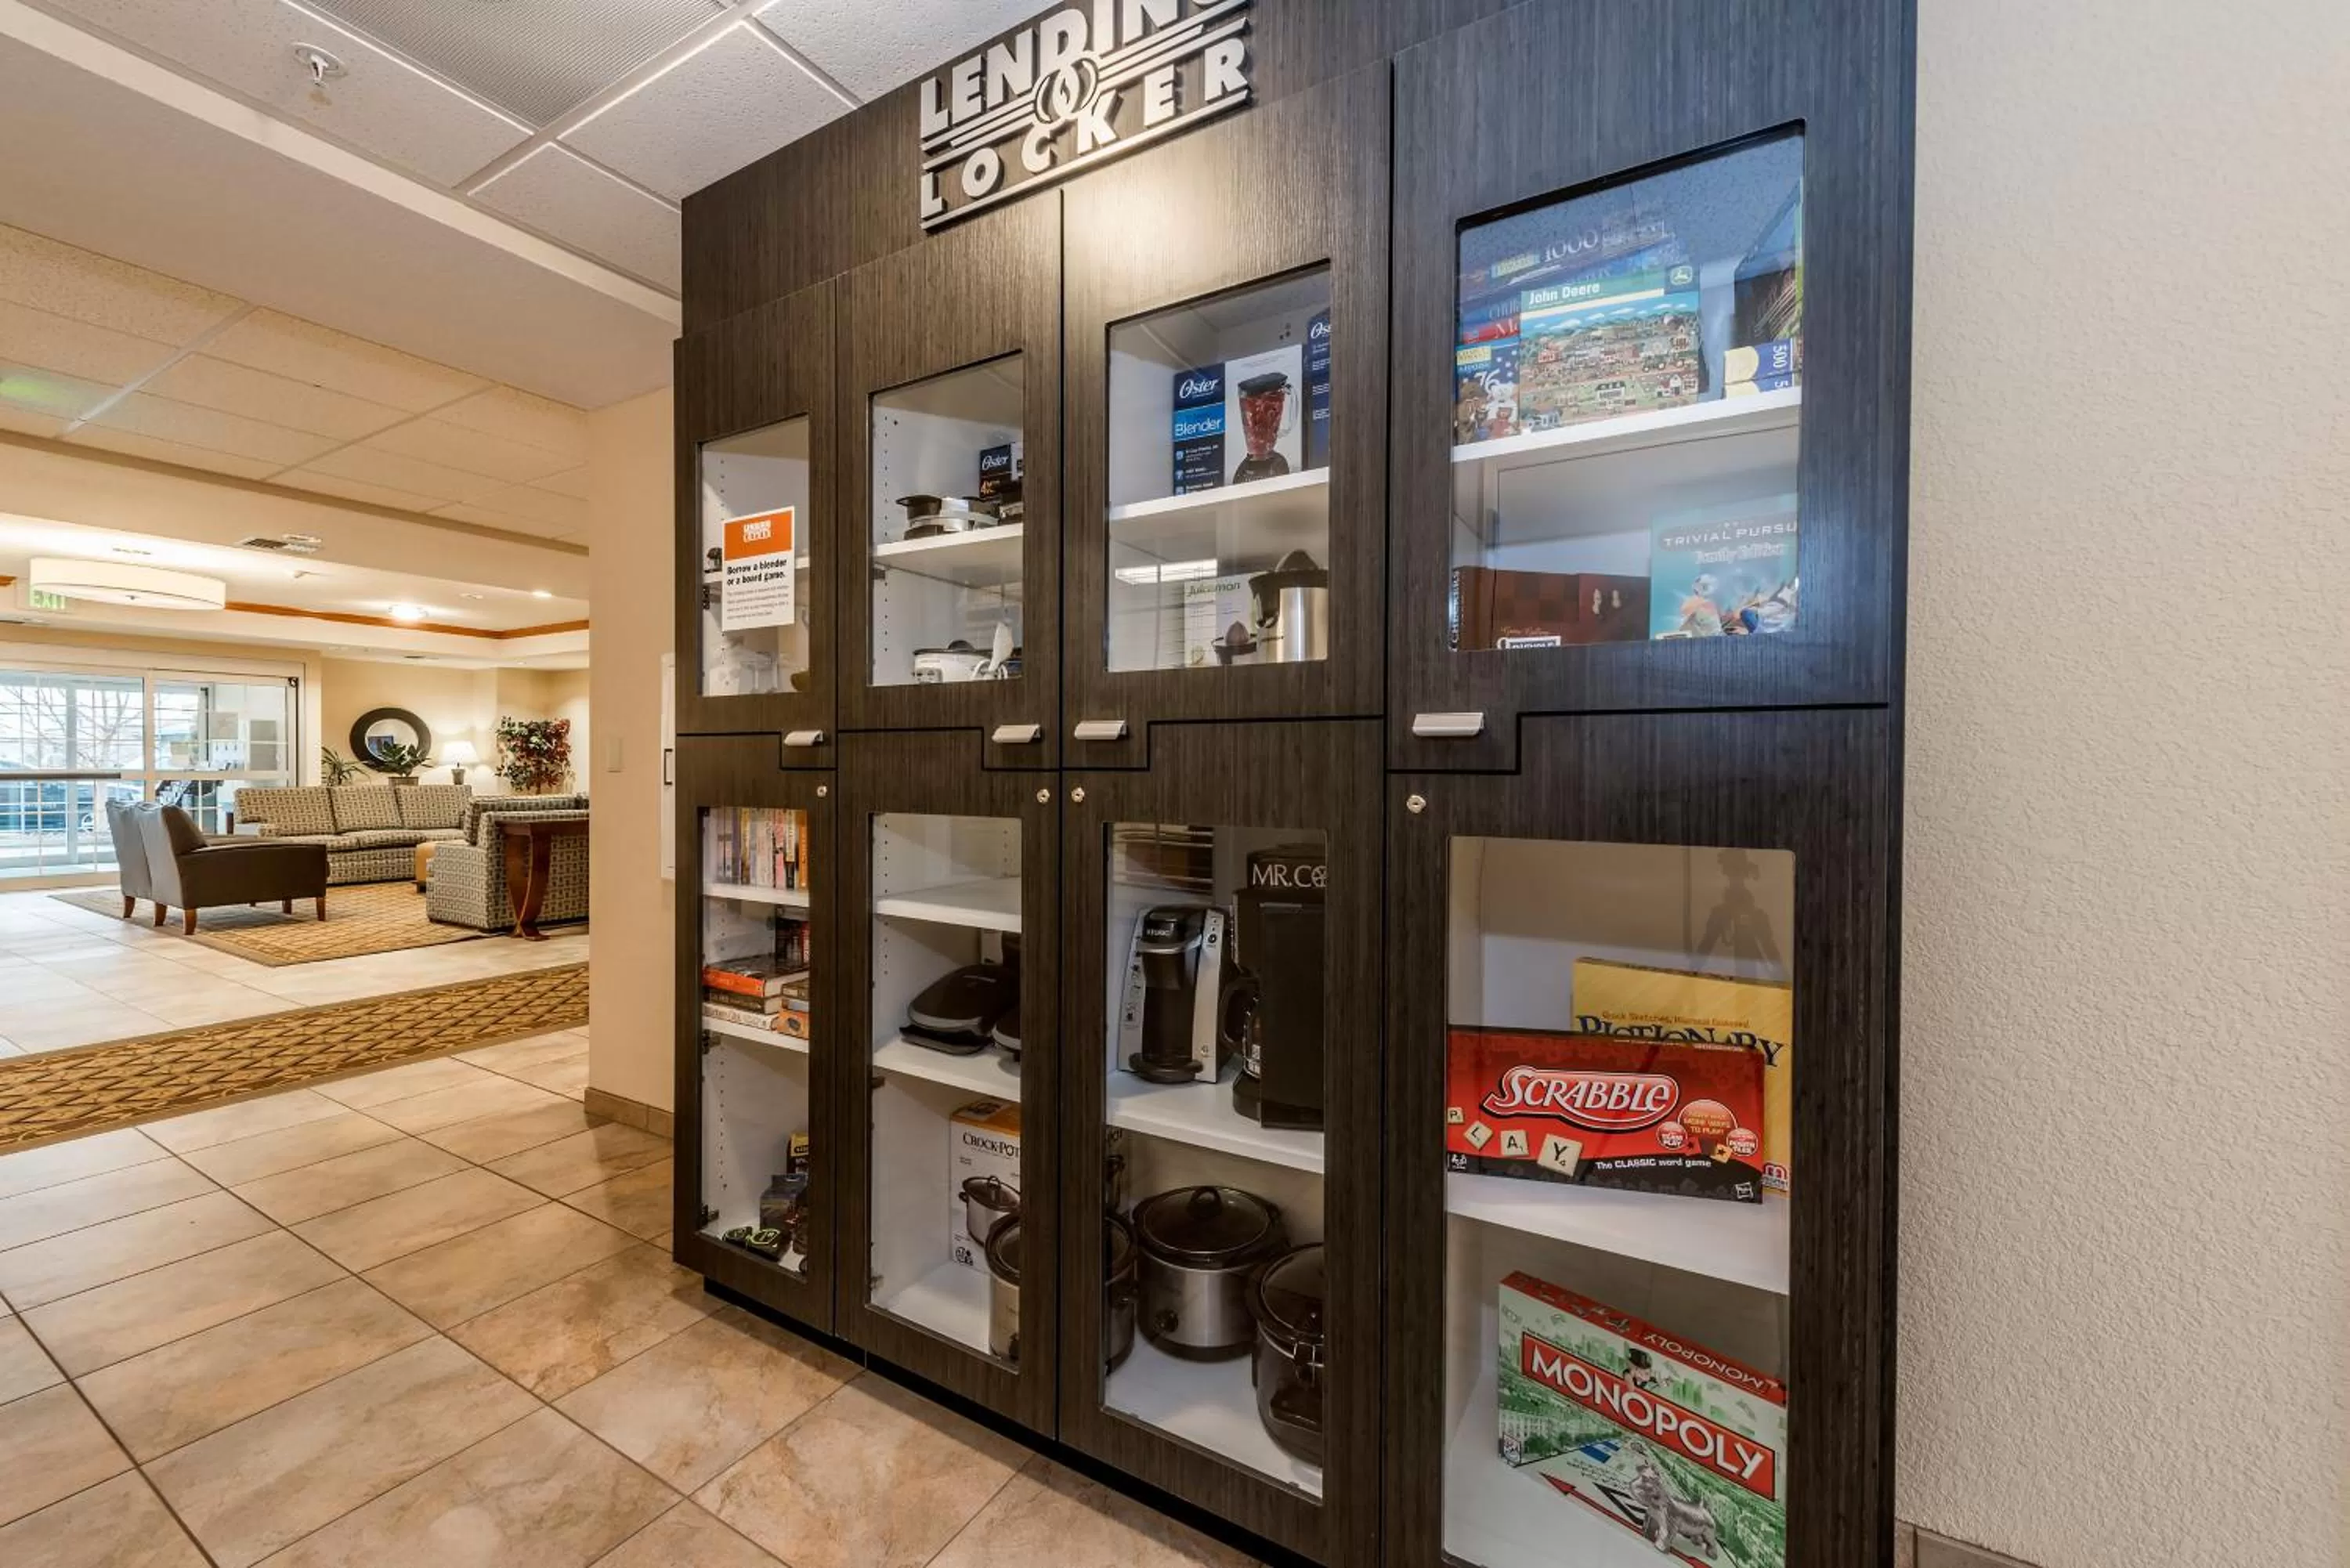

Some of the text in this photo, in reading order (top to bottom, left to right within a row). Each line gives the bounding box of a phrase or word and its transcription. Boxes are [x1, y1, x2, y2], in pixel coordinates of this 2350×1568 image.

[920, 0, 1222, 139] LENDIN
[920, 38, 1249, 219] LOCKER
[1529, 283, 1600, 305] John Deere
[1179, 378, 1220, 399] Oster
[1175, 418, 1222, 436] Blender
[1663, 529, 1732, 547] TRIVIAL
[727, 565, 751, 575] Borrow
[759, 558, 787, 569] blender
[742, 573, 762, 583] board
[1595, 1161, 1613, 1169] The
[1614, 1158, 1656, 1168] CLASSIC
[1658, 1158, 1683, 1166] word
[1531, 1344, 1766, 1480] MONOPOLY
